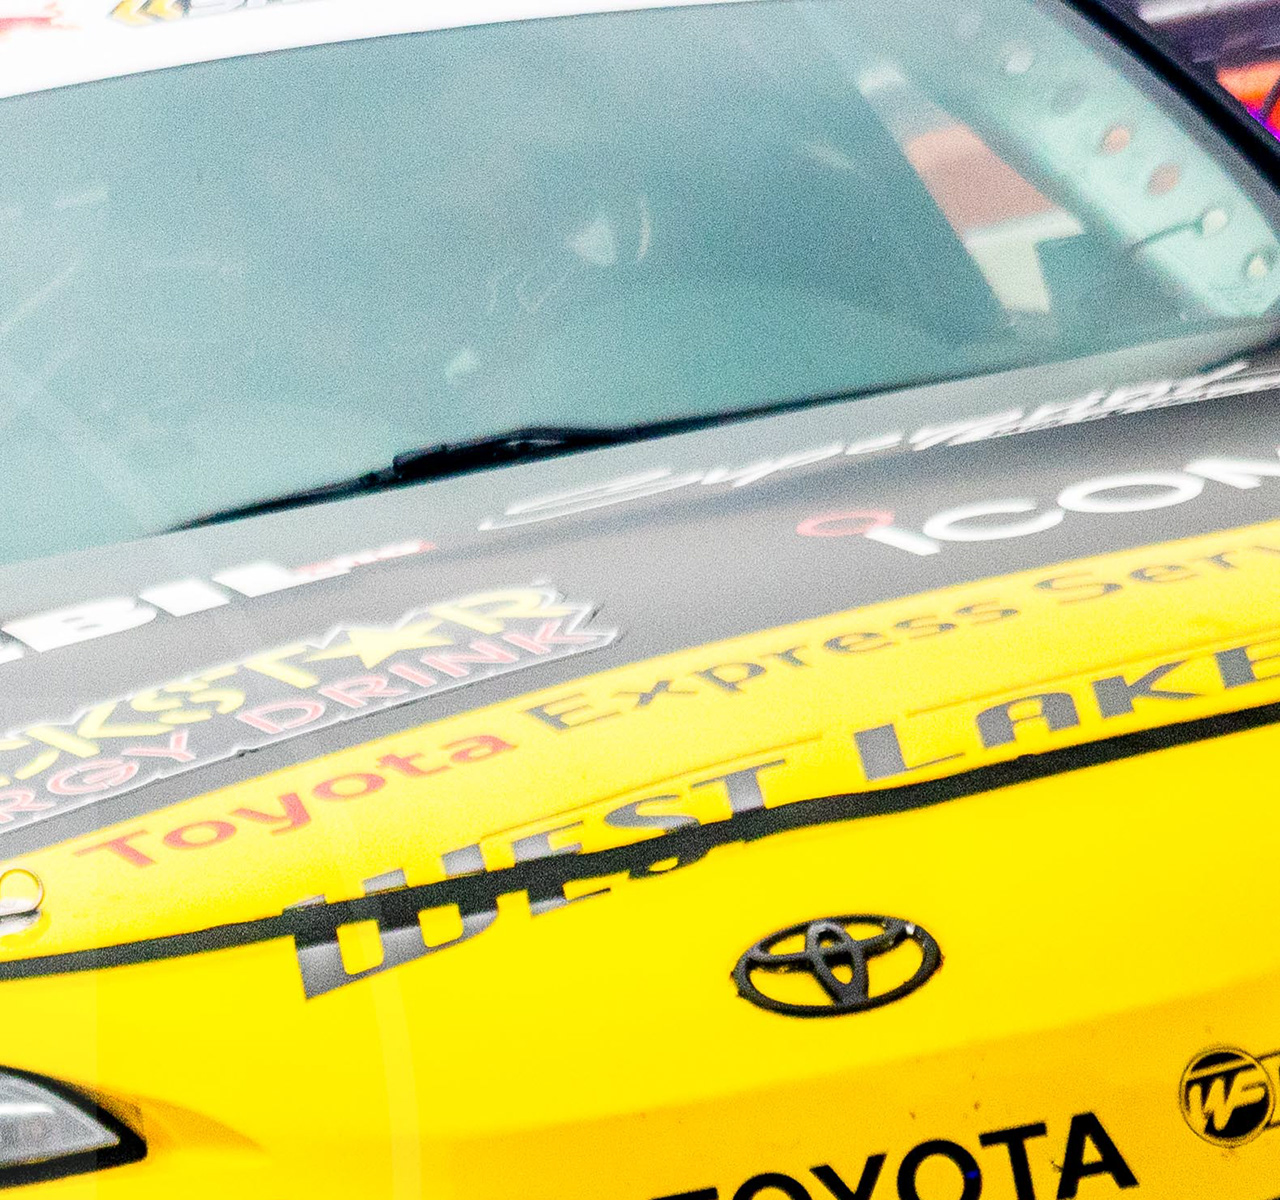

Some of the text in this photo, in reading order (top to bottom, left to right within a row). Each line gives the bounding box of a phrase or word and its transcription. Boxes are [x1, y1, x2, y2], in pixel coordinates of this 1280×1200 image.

[72, 732, 517, 871] Toyota
[518, 599, 1022, 735] Express
[237, 615, 600, 736] DRINK
